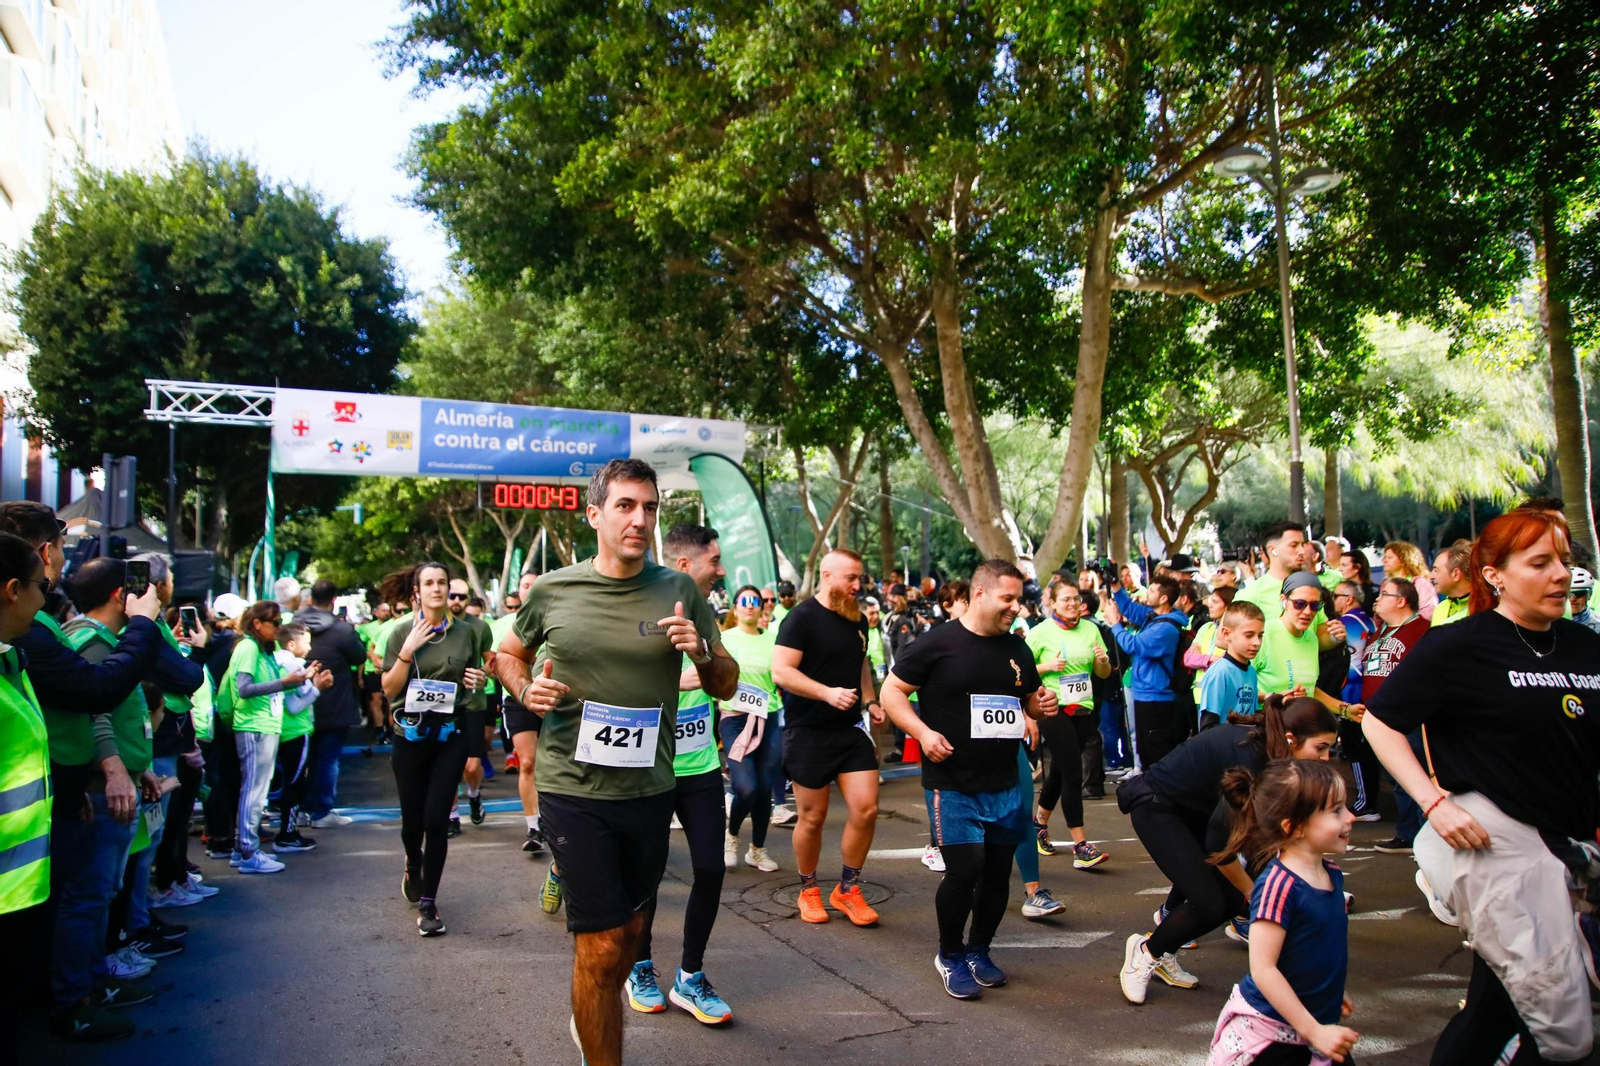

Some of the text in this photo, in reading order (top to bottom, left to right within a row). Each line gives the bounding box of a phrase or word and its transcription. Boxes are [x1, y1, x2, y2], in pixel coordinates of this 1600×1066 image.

[434, 408, 620, 435] Almería en marcha
[434, 433, 598, 455] contra el cáncer
[1067, 681, 1088, 694] 780
[1507, 670, 1600, 691] Crossfit Coac
[416, 690, 446, 704] 282
[739, 692, 763, 707] 806
[587, 704, 609, 713] Almería
[587, 711, 605, 719] contra
[983, 709, 1016, 725] 600
[594, 725, 644, 748] 421
[675, 719, 706, 740] 599
